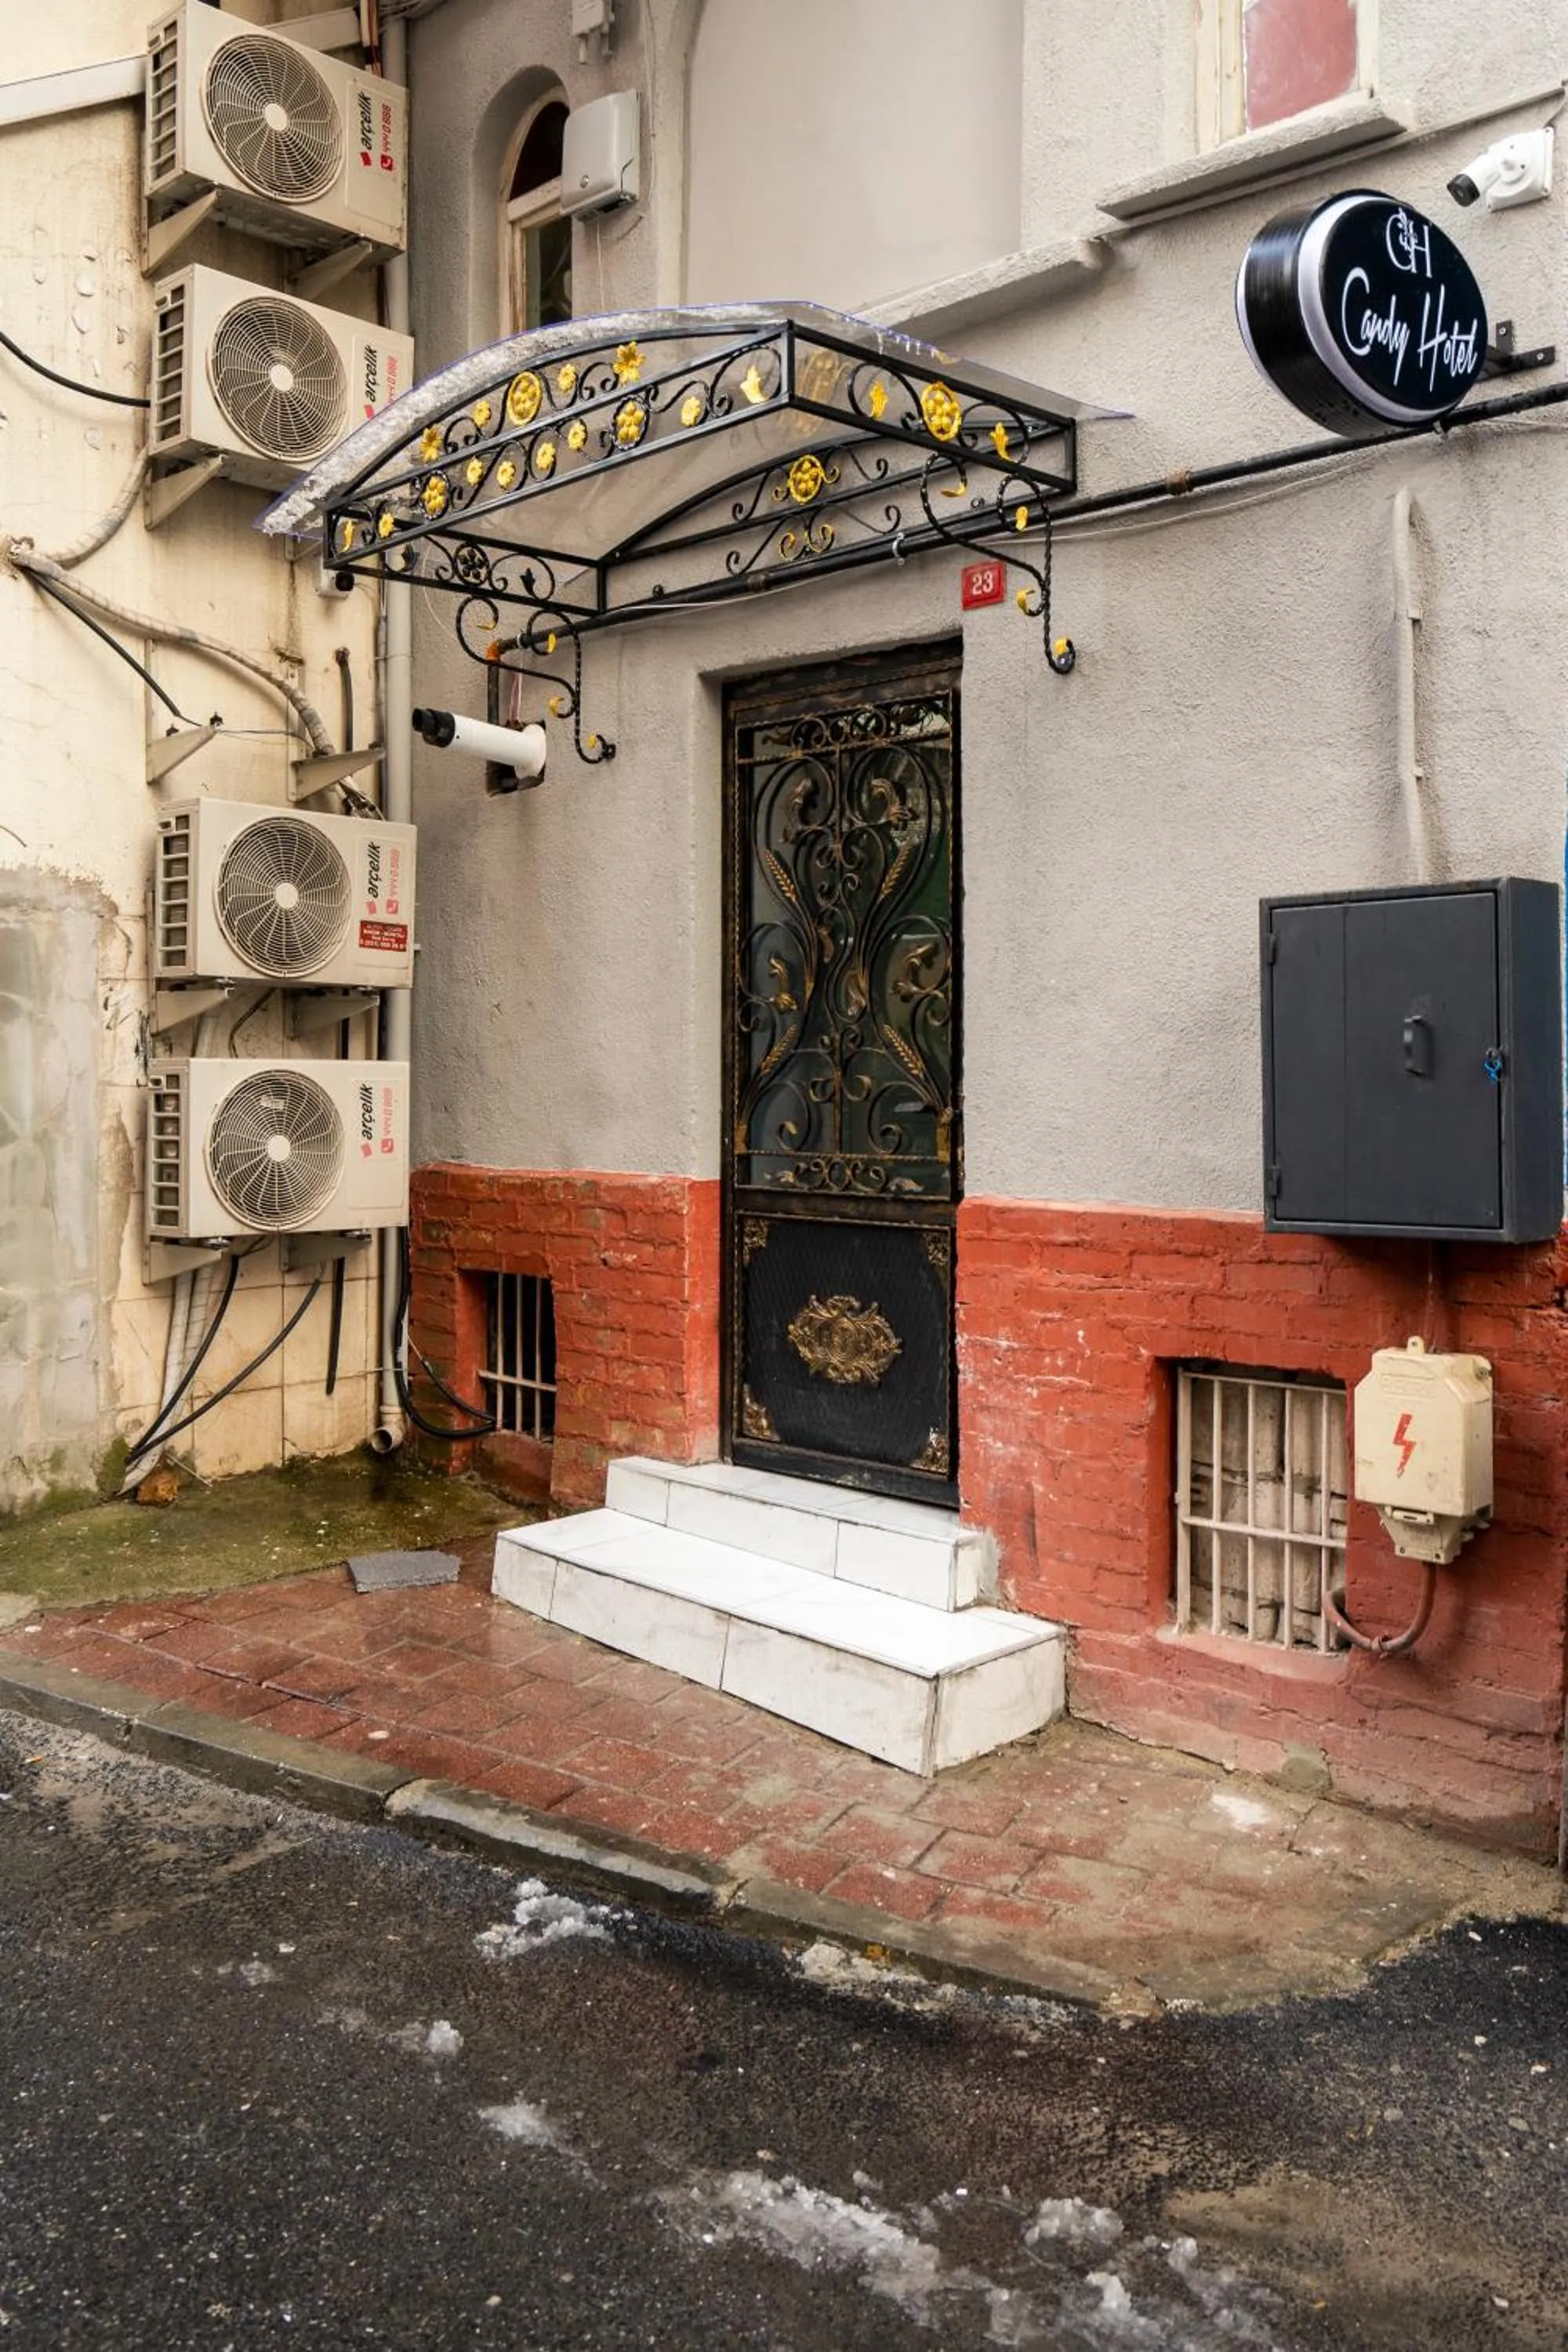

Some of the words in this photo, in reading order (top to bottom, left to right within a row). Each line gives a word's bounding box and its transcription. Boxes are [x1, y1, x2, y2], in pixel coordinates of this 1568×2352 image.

[358, 91, 375, 151] arçelik
[1341, 267, 1410, 387] Candy
[1417, 283, 1478, 392] Hotel
[364, 344, 379, 402] arçelik
[972, 570, 993, 595] 23
[367, 841, 381, 899] arçelik
[360, 1083, 375, 1140] arçelik
